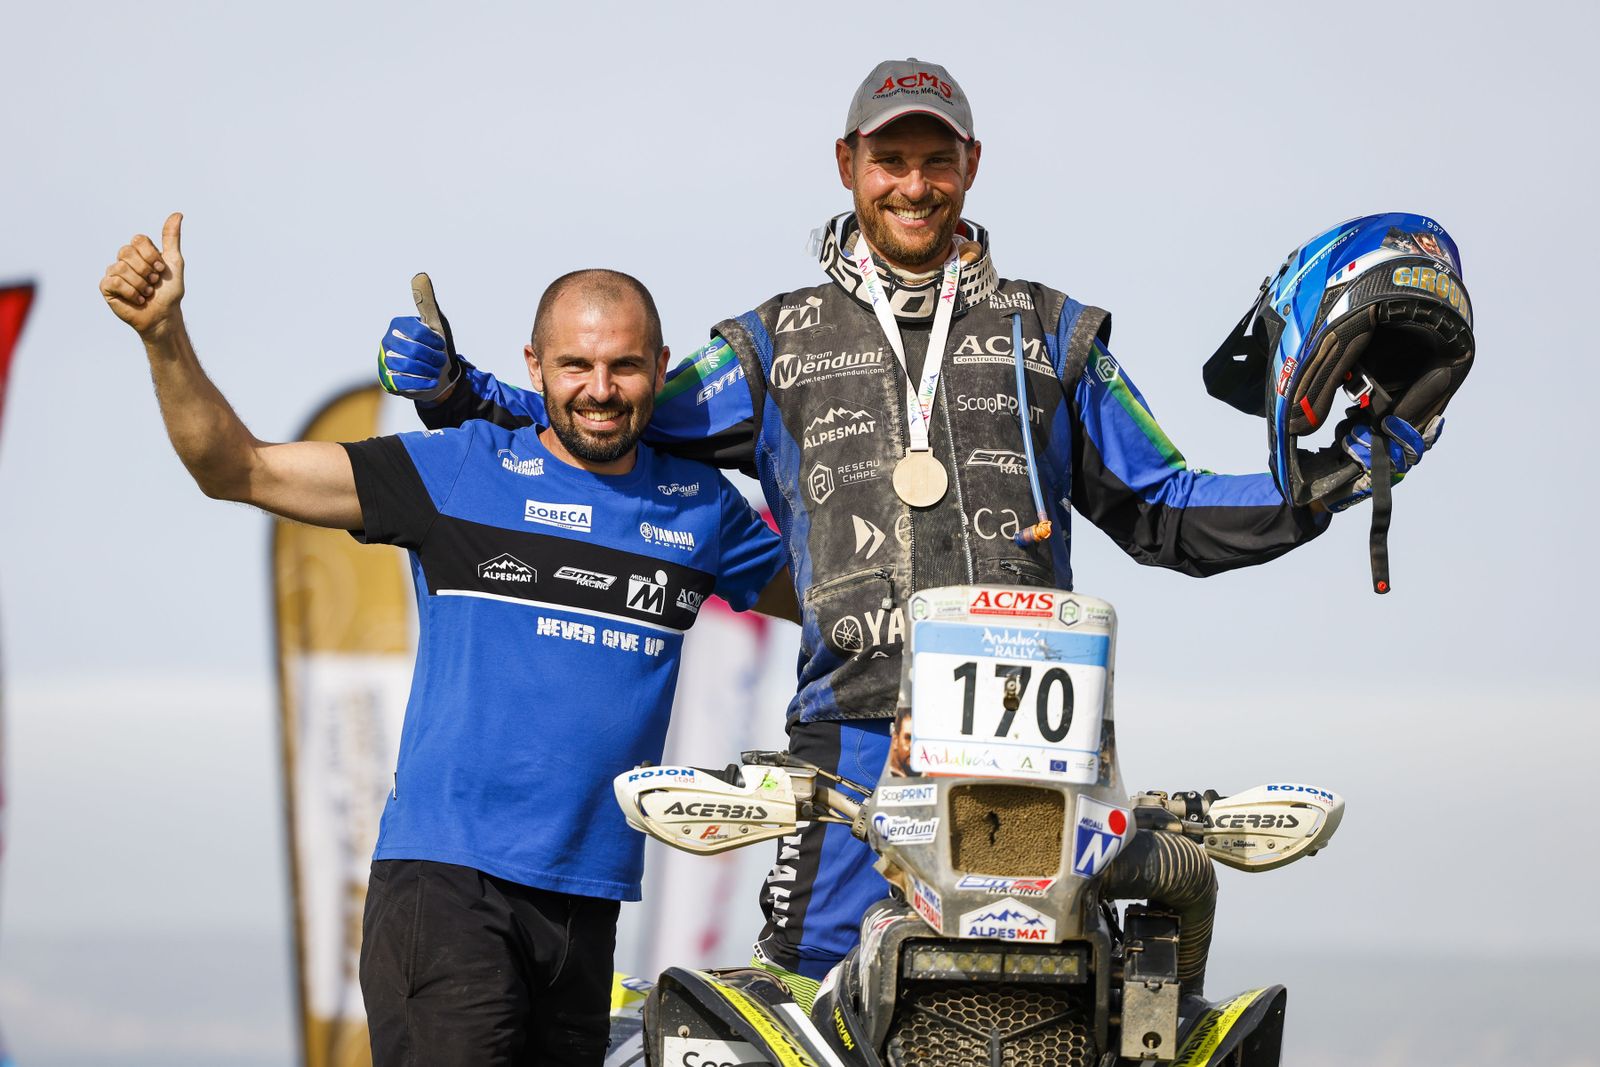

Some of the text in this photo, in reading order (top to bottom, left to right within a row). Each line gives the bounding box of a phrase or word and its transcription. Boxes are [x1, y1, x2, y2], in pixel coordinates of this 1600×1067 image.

[875, 72, 952, 98] ACMS
[1422, 218, 1444, 235] 1997
[805, 351, 833, 361] Team
[956, 355, 1015, 364] Constructions
[770, 347, 884, 389] Menduni
[1284, 359, 1294, 374] OK
[697, 364, 745, 406] GYT
[795, 368, 885, 388] www.team-menduni.com
[803, 421, 876, 450] ALPESMAT
[528, 506, 588, 524] SOBECA
[652, 525, 695, 547] YAMAHA
[483, 571, 533, 583] ALPESMAT
[576, 579, 609, 590] RACING
[971, 591, 1054, 610] ACMS
[536, 616, 665, 657] NEVER GIVE UP
[995, 645, 1037, 659] RALLY
[953, 661, 1074, 743] 170
[920, 744, 1001, 770] Andalucía
[629, 769, 694, 783] ROJON
[1266, 785, 1334, 801] ROJON
[988, 886, 1043, 896] RACING
[968, 926, 1047, 940] ALPESMAT
